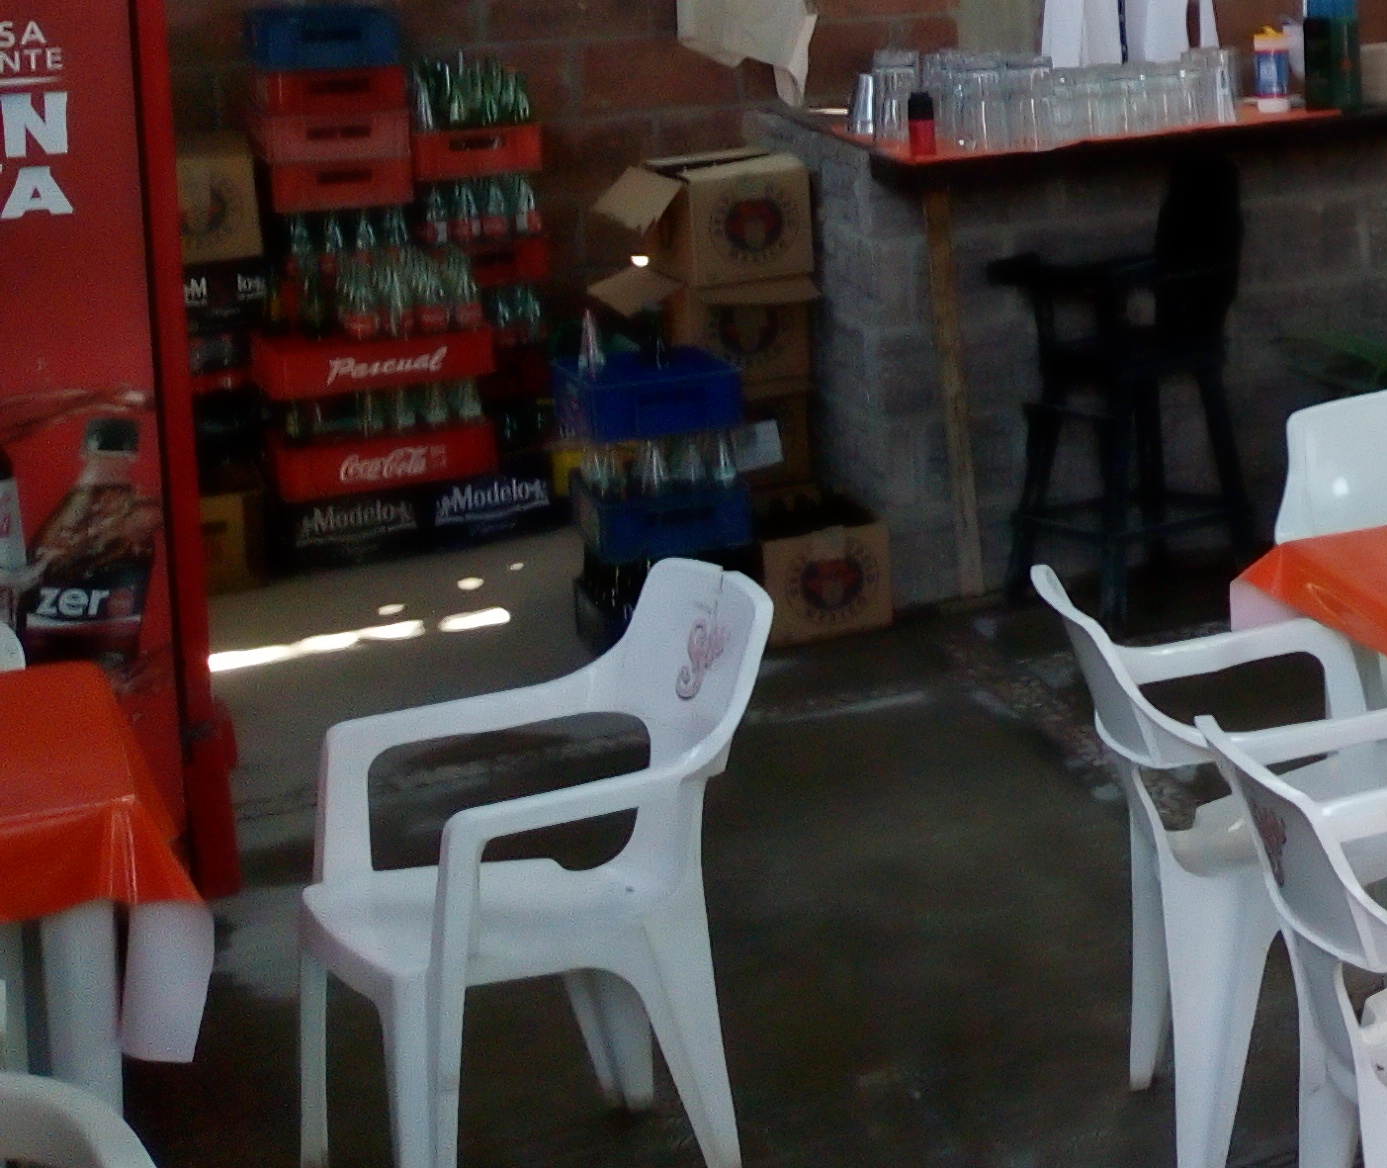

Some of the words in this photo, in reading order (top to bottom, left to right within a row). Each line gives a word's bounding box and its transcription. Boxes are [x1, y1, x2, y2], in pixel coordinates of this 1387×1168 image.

[326, 345, 448, 387] Pascual
[451, 477, 532, 513] Modelo
[313, 499, 392, 533] Modelo
